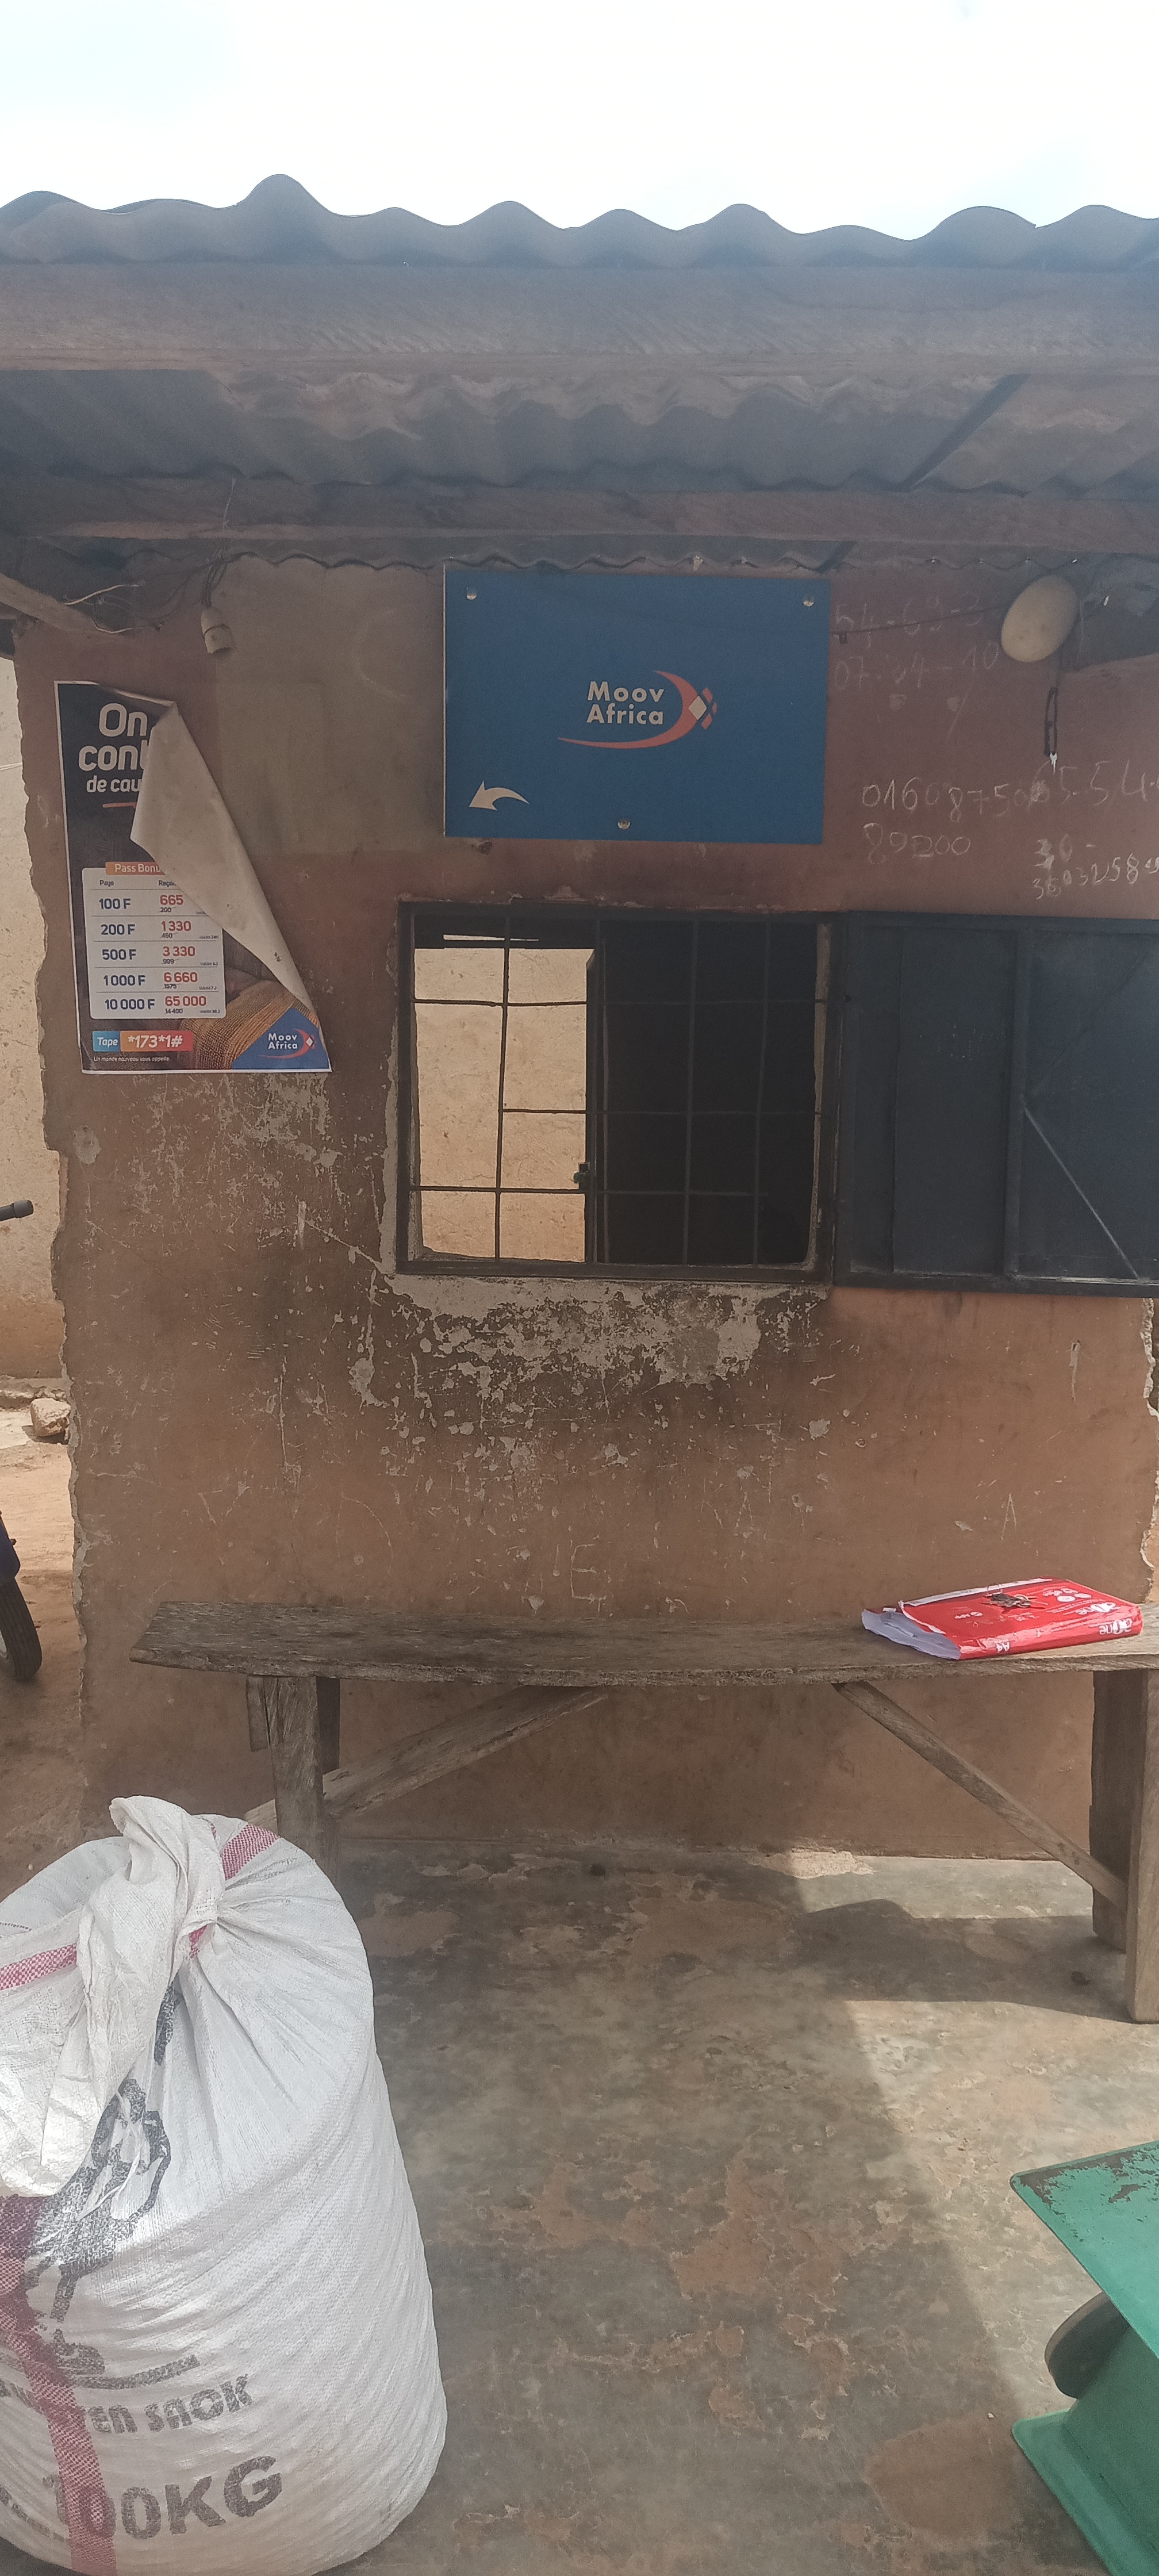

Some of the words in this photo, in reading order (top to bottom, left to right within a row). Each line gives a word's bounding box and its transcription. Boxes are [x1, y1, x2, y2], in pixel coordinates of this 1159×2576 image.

[587, 681, 665, 702] Moov
[99, 703, 148, 737] On
[586, 704, 664, 725] Africa
[86, 775, 107, 793] de
[114, 864, 136, 873] Pass
[99, 898, 120, 910] 100
[122, 898, 131, 909] F
[160, 895, 183, 906] 665
[101, 925, 125, 936] 200
[128, 924, 136, 935] F
[102, 949, 126, 960] 500
[129, 949, 137, 960] F
[137, 975, 146, 986] F
[147, 999, 155, 1010] F
[97, 1037, 118, 1048] Tape
[268, 1033, 298, 1042] Moov
[267, 1041, 298, 1051] Africa
